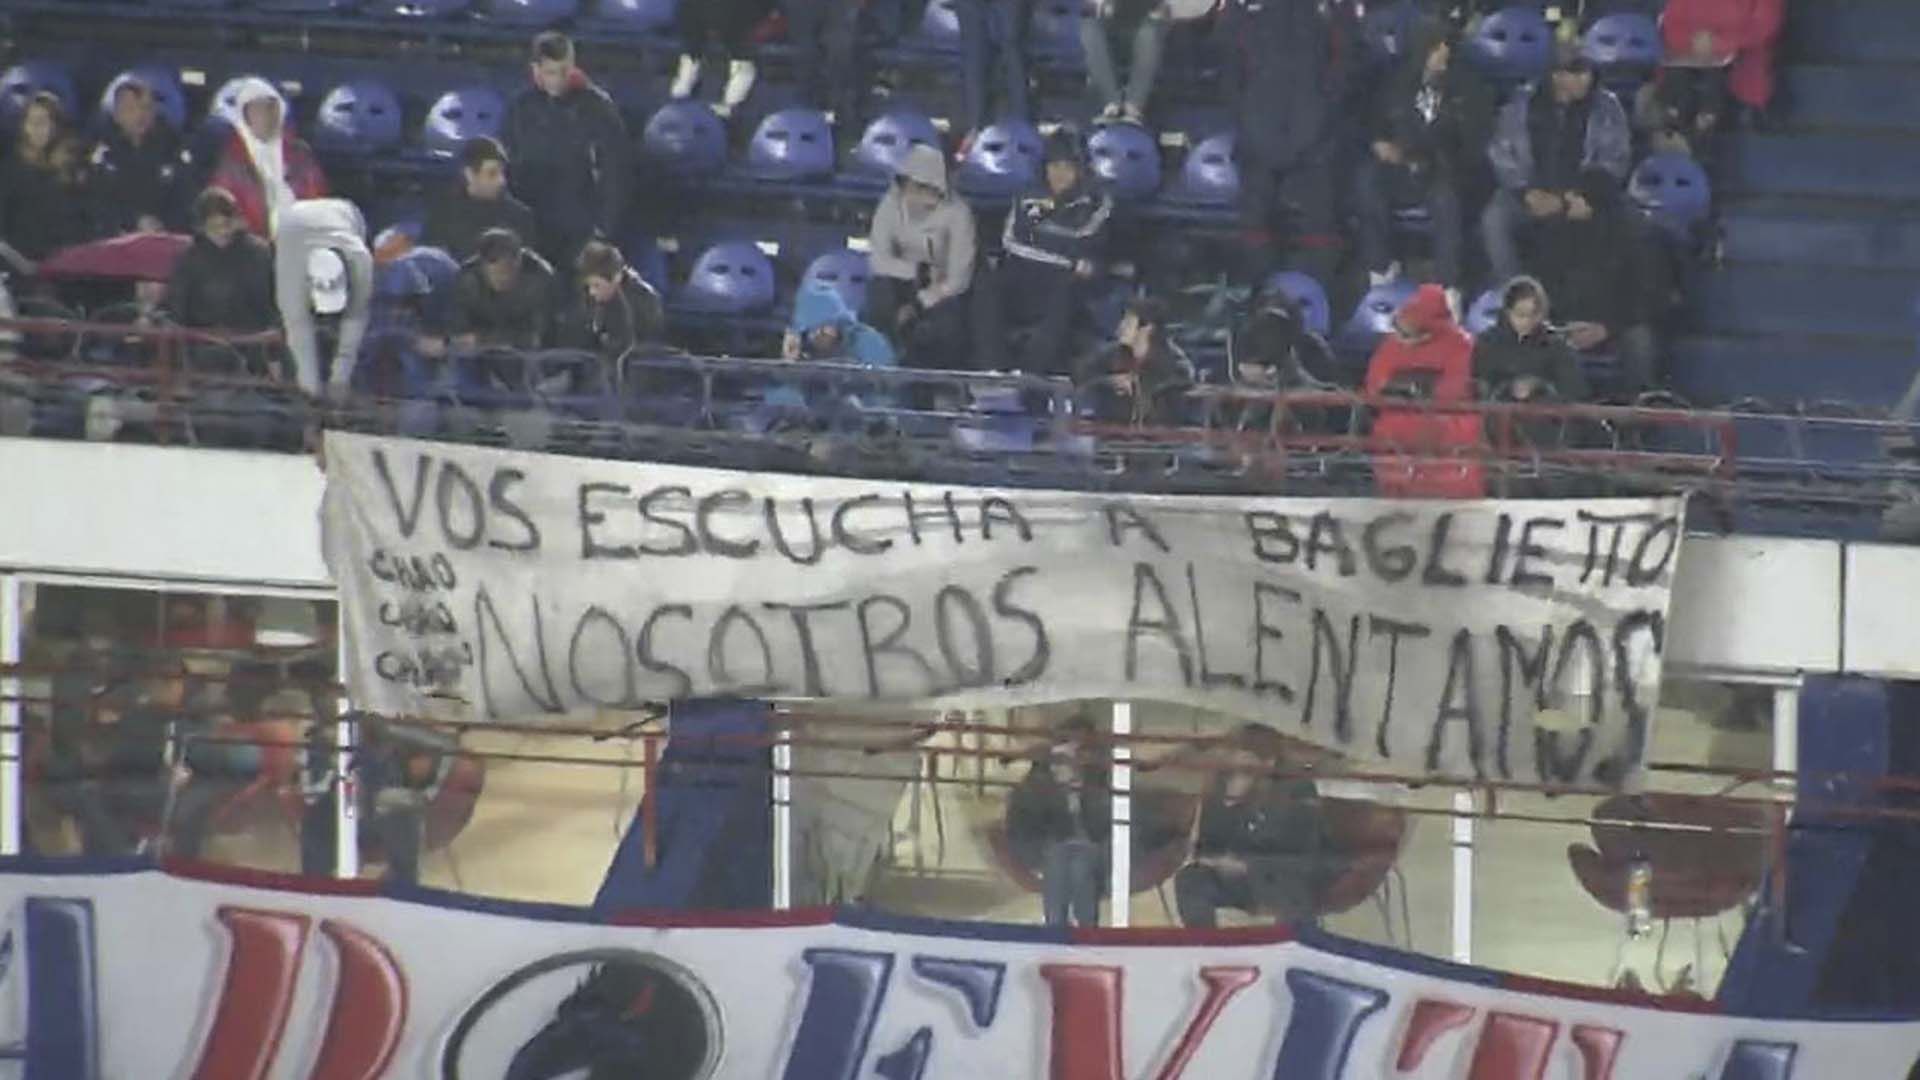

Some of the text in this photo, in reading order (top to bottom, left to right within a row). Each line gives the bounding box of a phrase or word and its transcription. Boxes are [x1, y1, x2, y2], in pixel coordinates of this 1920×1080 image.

[373, 451, 1680, 587] VOS ESCUCHA A BAGLIETTO
[475, 560, 1665, 790] NOSOTROS ALENTAMOS
